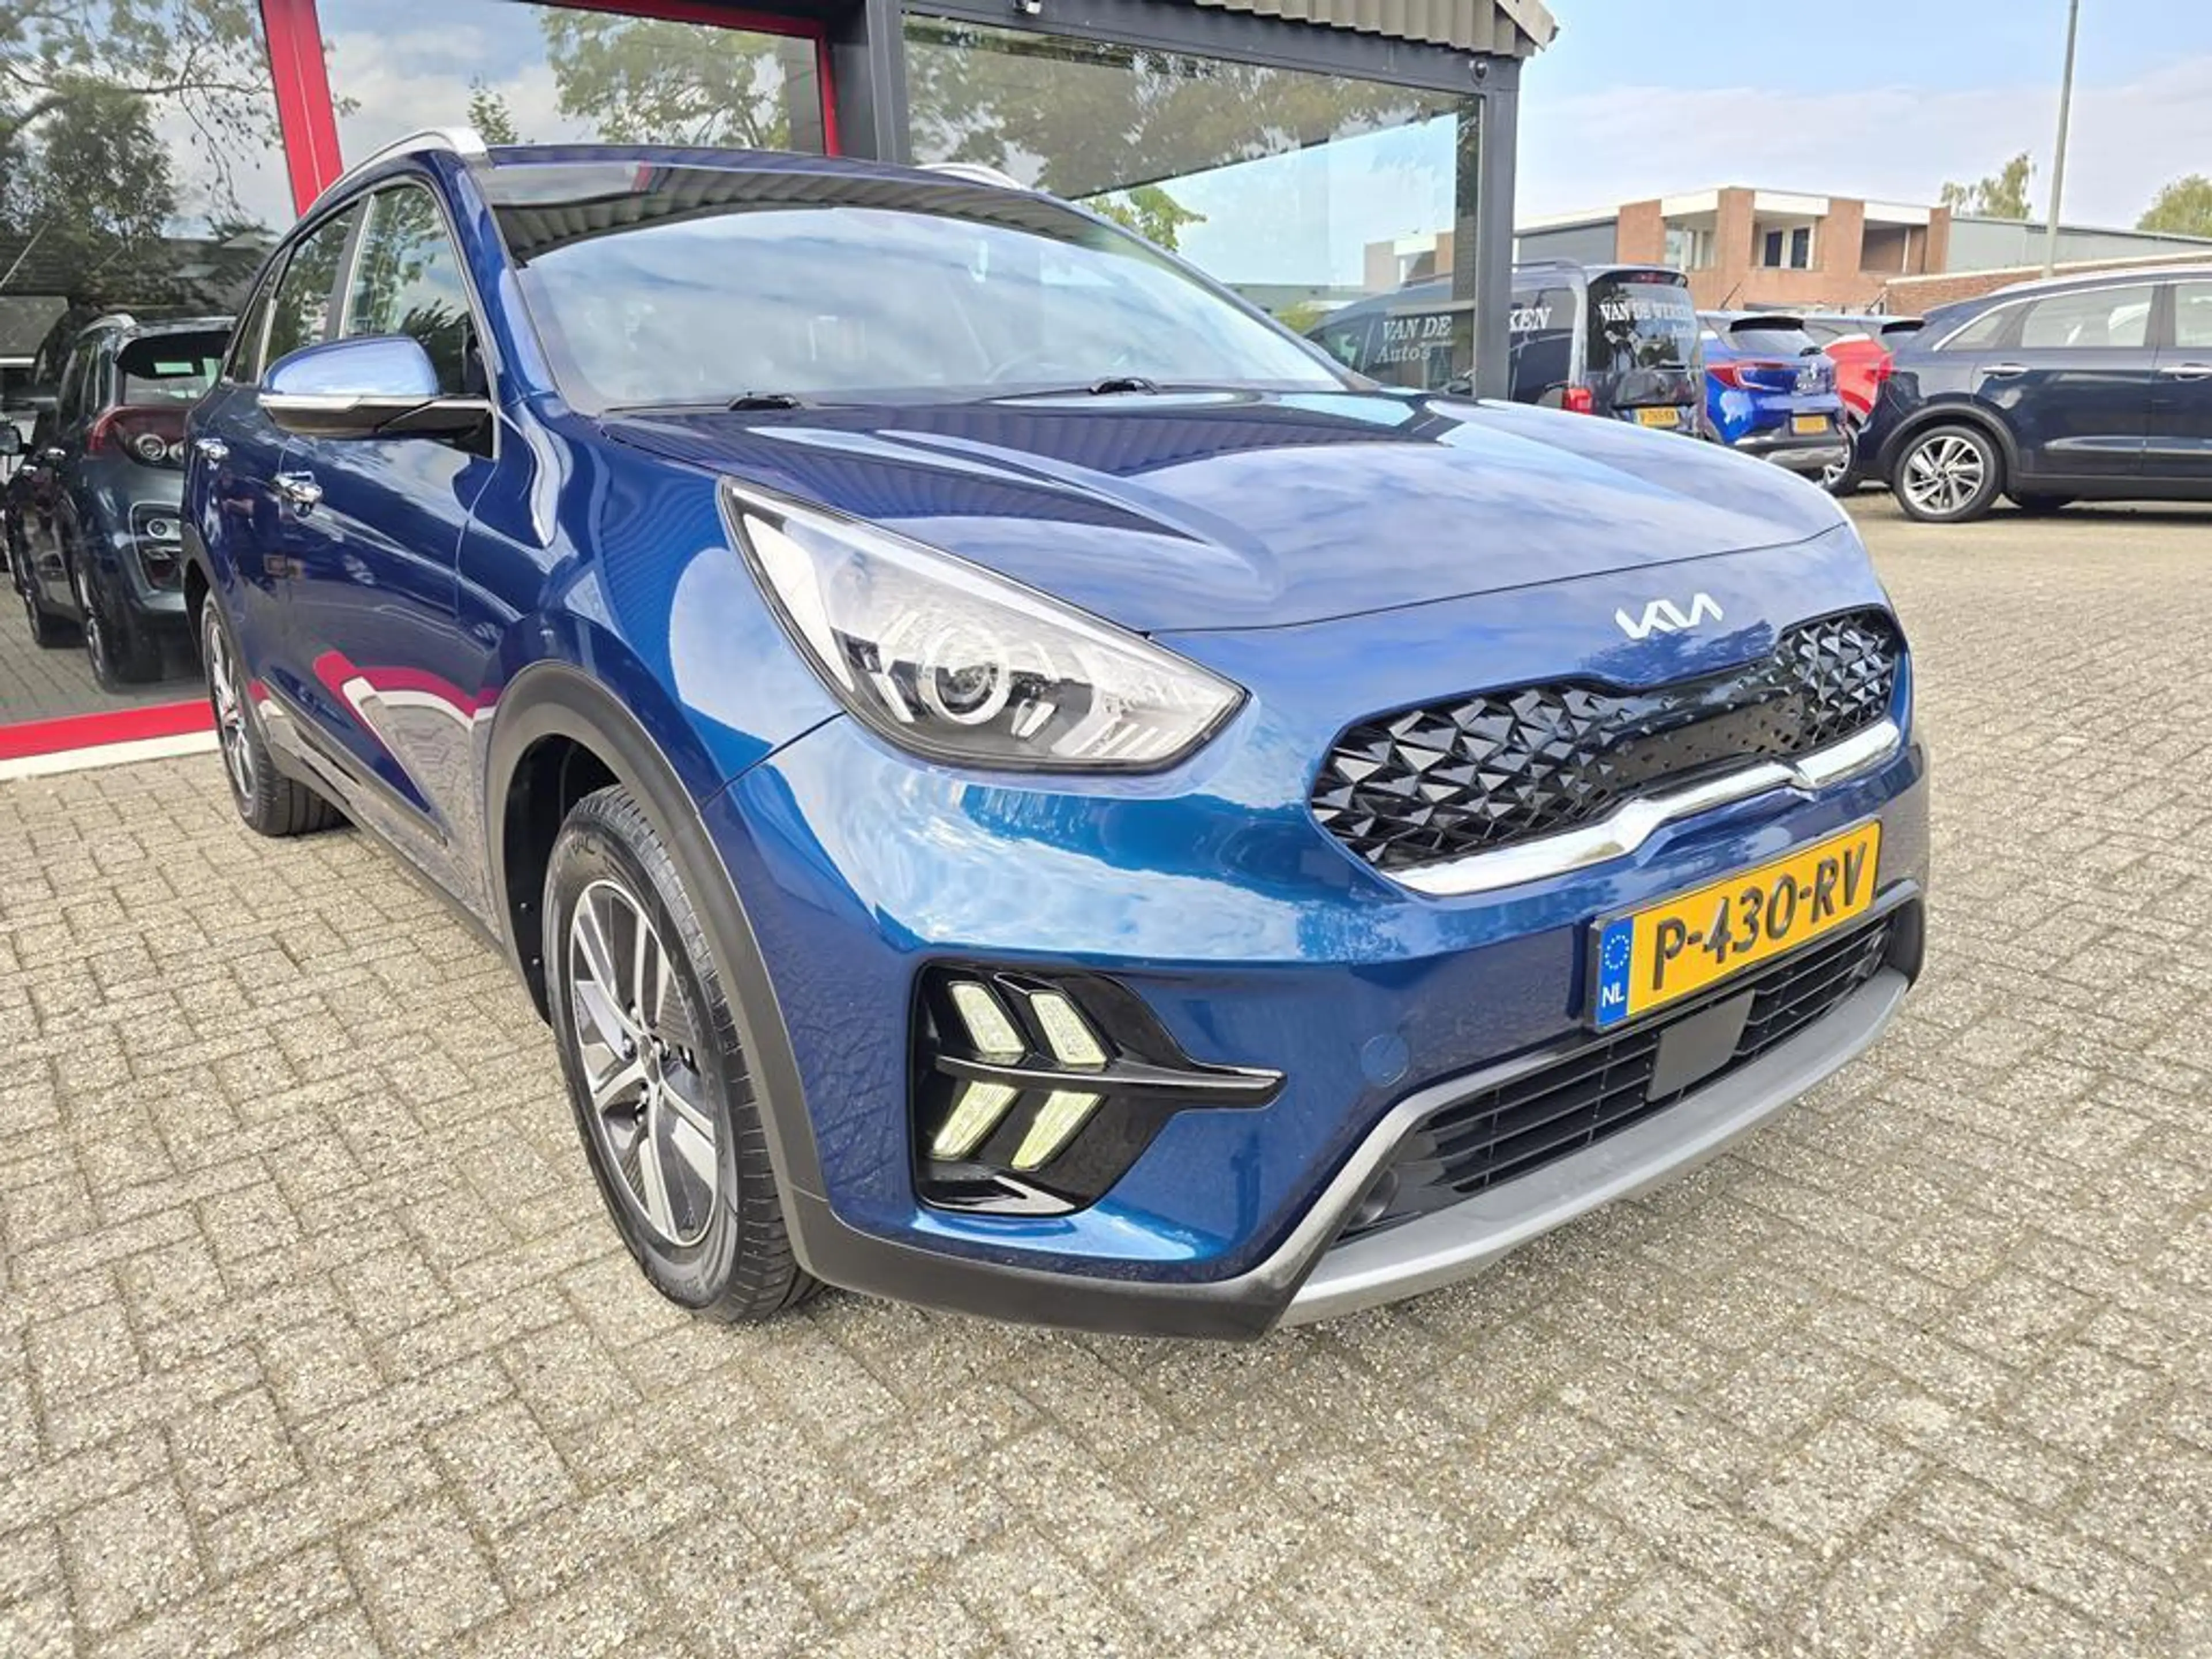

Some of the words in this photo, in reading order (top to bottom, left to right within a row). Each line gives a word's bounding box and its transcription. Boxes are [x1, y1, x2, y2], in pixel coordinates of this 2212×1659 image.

[1383, 319, 1420, 341] VAN
[1421, 316, 1452, 338] DE
[1615, 593, 1724, 639] KIA
[1653, 842, 1867, 990] P-430-RV
[1602, 983, 1625, 1007] NL
